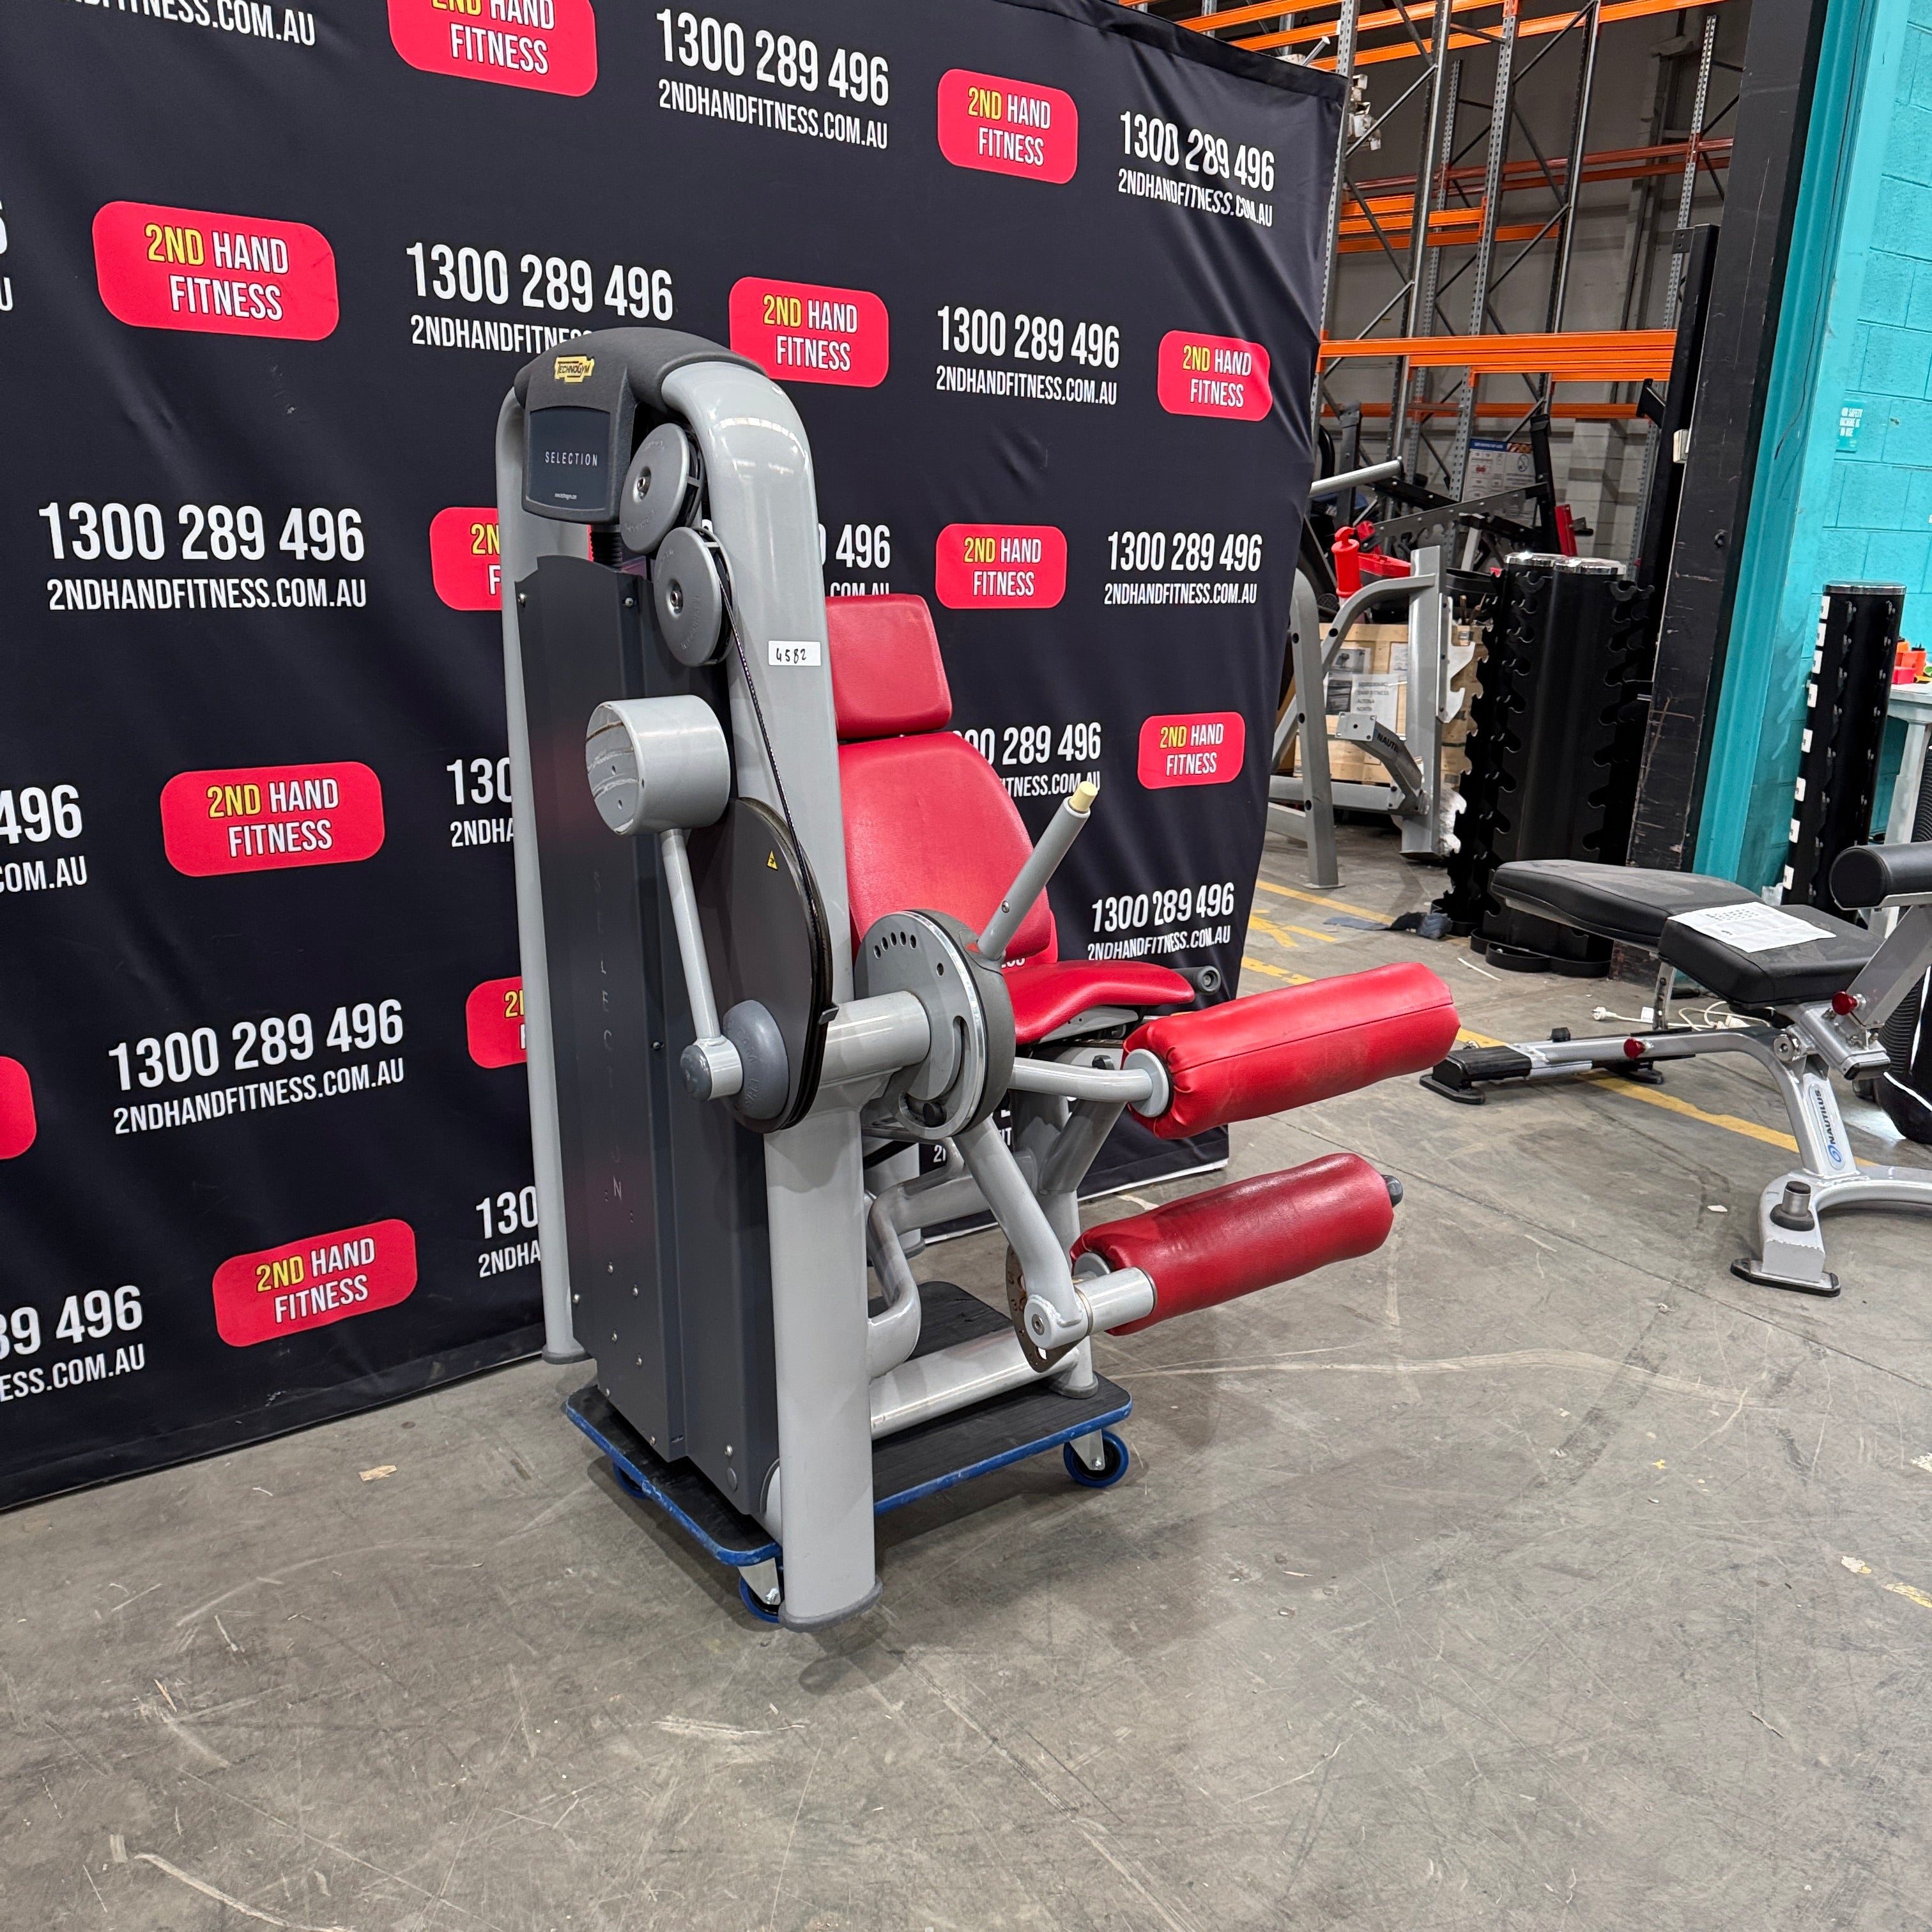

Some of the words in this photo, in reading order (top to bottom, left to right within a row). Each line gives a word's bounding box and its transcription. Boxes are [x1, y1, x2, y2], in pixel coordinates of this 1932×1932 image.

[491, 0, 554, 29] HAND
[451, 24, 548, 73] FITNESS
[657, 9, 744, 75] 1300
[756, 30, 818, 91] 289
[828, 49, 888, 105] 496
[659, 79, 887, 149] 2NDHANDFITNESS.COM.AU
[969, 88, 1001, 119] 2ND
[1008, 95, 1050, 128] HAND
[979, 127, 1043, 165] FITNESS
[1121, 111, 1179, 165] 1300
[1185, 129, 1229, 178] 289
[1234, 145, 1274, 191] 496
[1119, 169, 1272, 227] 2NDHANDFITNESS.COM.AU
[146, 225, 204, 264] 2ND
[213, 232, 288, 273] HAND
[170, 275, 282, 320] FITNESS
[406, 242, 508, 304] 1300
[521, 254, 592, 312] 289
[604, 265, 672, 321] 496
[764, 295, 801, 326] 2ND
[808, 300, 857, 332] HAND
[778, 336, 850, 371] FITNESS
[938, 306, 1006, 356] 1300
[1015, 314, 1063, 362] 289
[1071, 323, 1119, 368] 496
[1183, 345, 1210, 371] 2ND
[1215, 349, 1252, 376] HAND
[937, 365, 1117, 405] 2NDHANDFITNESS.COM.AU
[1191, 379, 1243, 407] FITNESS
[545, 451, 598, 466] SELECTION
[39, 502, 164, 560] 1300
[179, 505, 264, 560] 289
[280, 508, 364, 561] 496
[471, 523, 500, 555] 2N
[836, 525, 890, 568] 496
[965, 537, 995, 562] 2ND
[1001, 538, 1041, 563] HAND
[1108, 532, 1165, 571] 1300
[1171, 533, 1215, 571] 289
[1220, 534, 1262, 571] 496
[47, 578, 365, 610] 2NDHANDFITNESS.COM.AU
[974, 571, 1034, 595] FITNESS
[1105, 583, 1257, 604] 2NDHANDFITNESS.COM.AU
[776, 647, 807, 664] 4582
[1002, 726, 1050, 765] 289
[1057, 723, 1101, 761] 496
[1160, 726, 1186, 748] 2ND
[1191, 724, 1223, 746] HAND
[447, 757, 512, 805] 130
[1167, 752, 1216, 776] FITNESS
[0, 785, 82, 843] 496
[208, 785, 260, 817] 2ND
[270, 779, 338, 812] HAND
[229, 820, 332, 857] FITNESS
[1092, 894, 1148, 931] 1300
[1153, 888, 1192, 925] 289
[1196, 882, 1234, 917] 496
[1088, 925, 1230, 960] 2NDHANDFITNESS.COM.AU
[109, 1028, 218, 1090] 1300
[233, 1014, 313, 1070] 289
[326, 999, 402, 1052] 496
[114, 1058, 403, 1134] 2NDHANDFITNESS.COM.AU
[1814, 1088, 1836, 1145] NAUTILUS
[476, 1186, 538, 1239] 130
[257, 1257, 303, 1291] 2ND
[312, 1238, 374, 1276] HAND
[56, 1285, 142, 1343] 496
[275, 1275, 367, 1322] FITNESS
